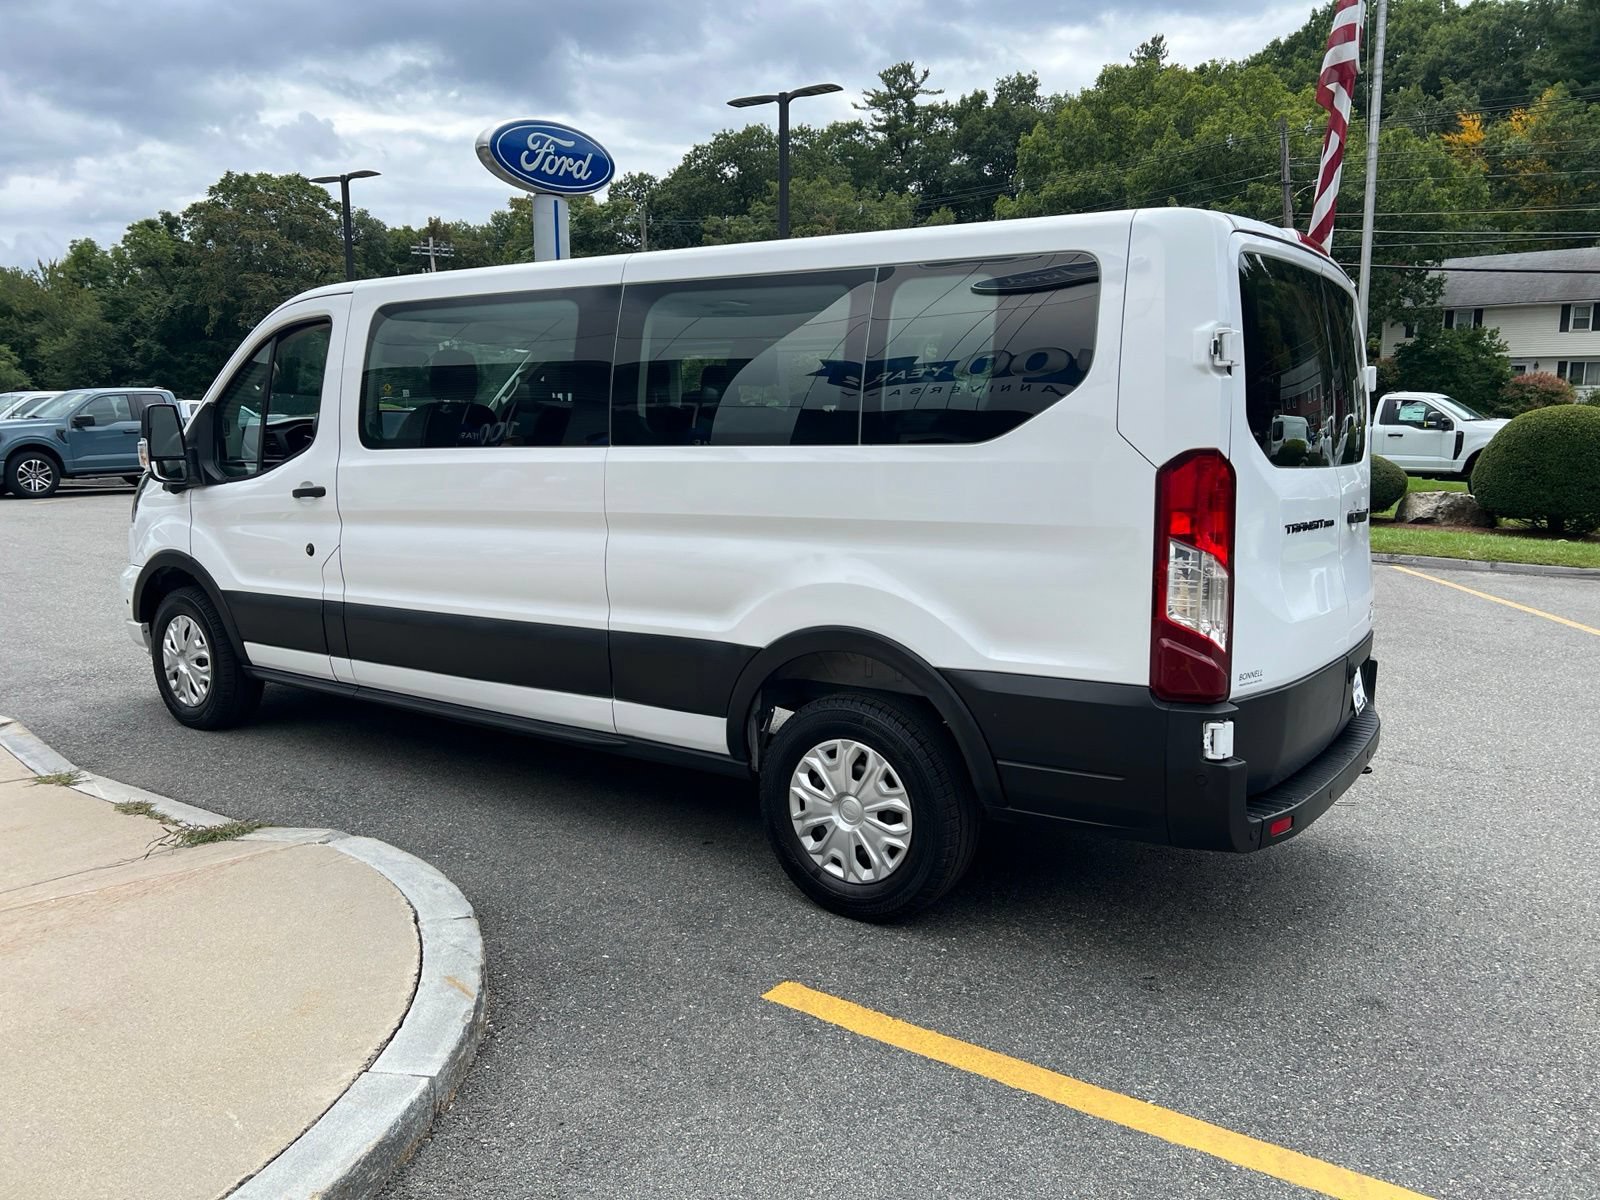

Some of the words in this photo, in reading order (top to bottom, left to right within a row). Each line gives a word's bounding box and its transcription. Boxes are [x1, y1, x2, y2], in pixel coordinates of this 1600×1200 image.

[520, 132, 592, 181] Ford
[1285, 518, 1324, 535] TRANSIT
[1238, 669, 1263, 682] BONNELL
